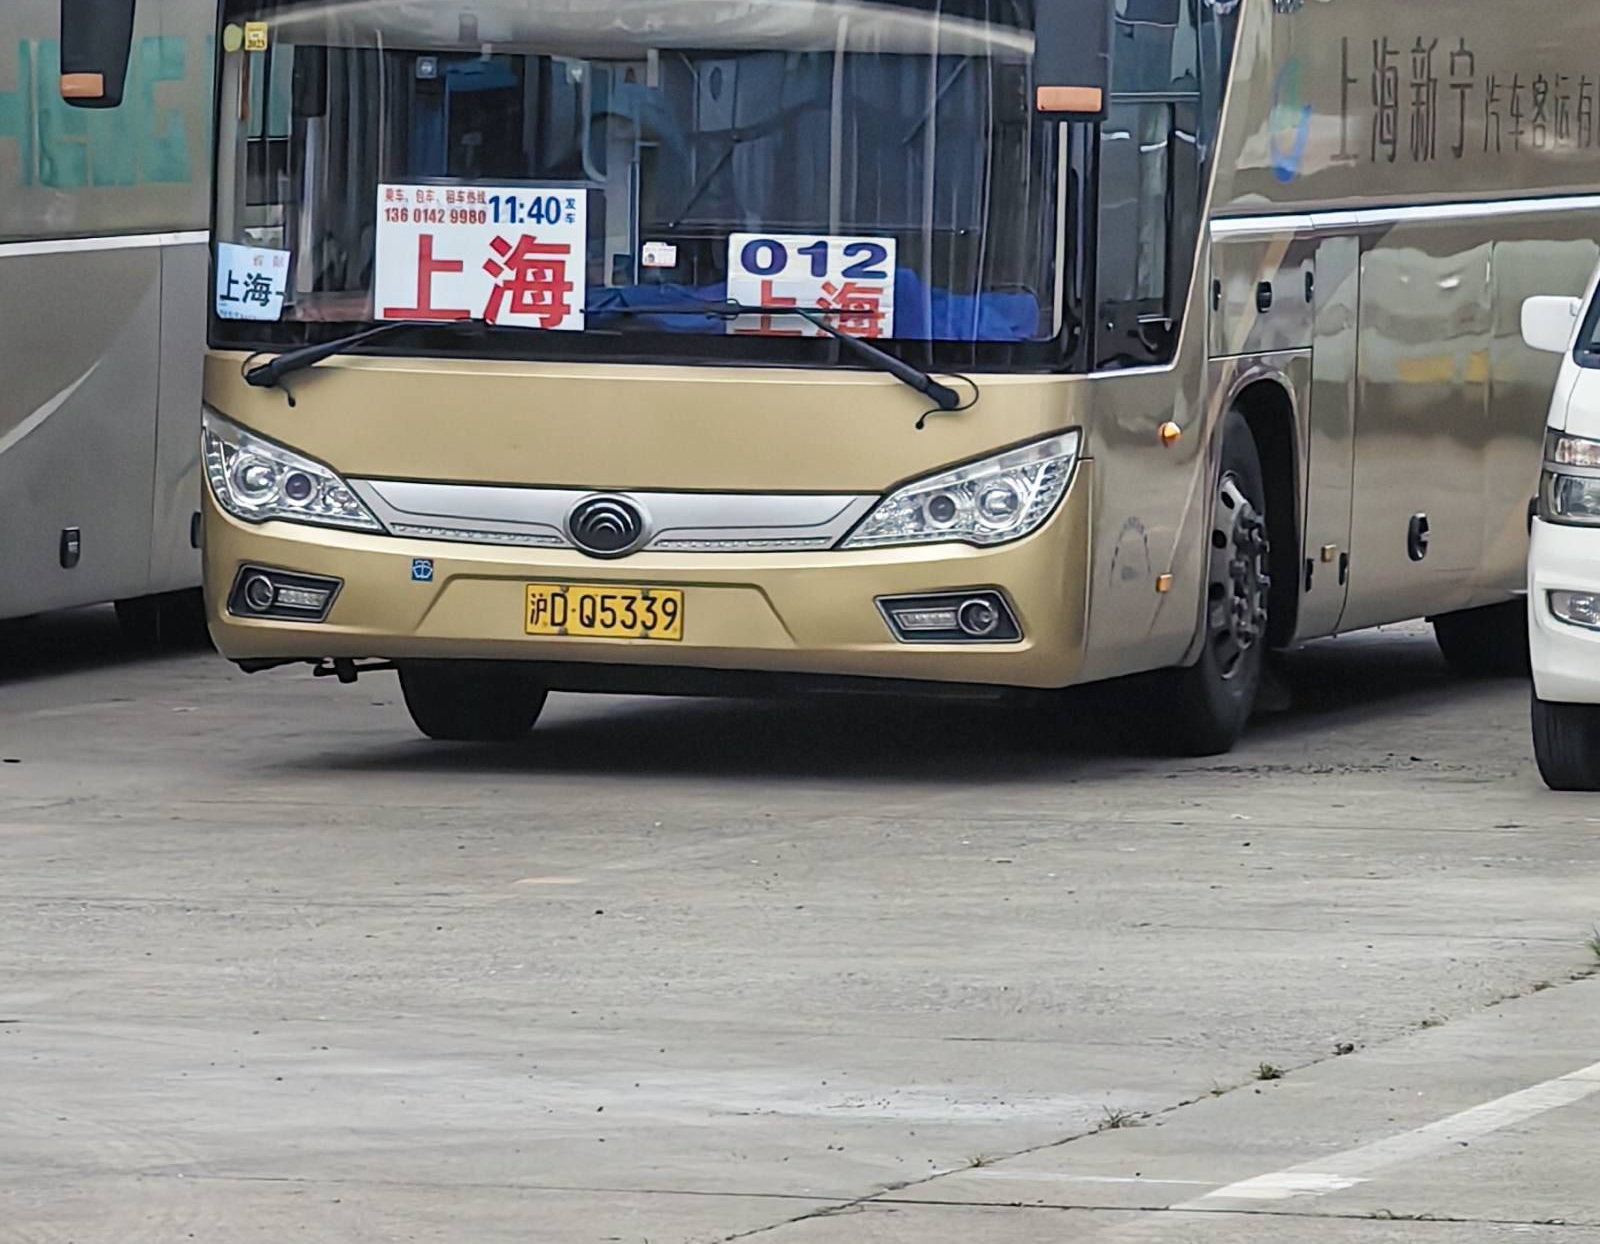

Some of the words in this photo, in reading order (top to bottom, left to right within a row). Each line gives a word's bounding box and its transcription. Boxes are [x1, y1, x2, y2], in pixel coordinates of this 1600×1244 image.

[1330, 36, 1600, 163] 上海新宁汽车客运有
[384, 207, 409, 223] 136
[413, 208, 446, 224] 0142
[450, 209, 487, 225] 9980
[489, 195, 561, 225] 11:40
[383, 233, 574, 329] 上海
[740, 238, 888, 279] 012
[734, 280, 886, 338] 上海
